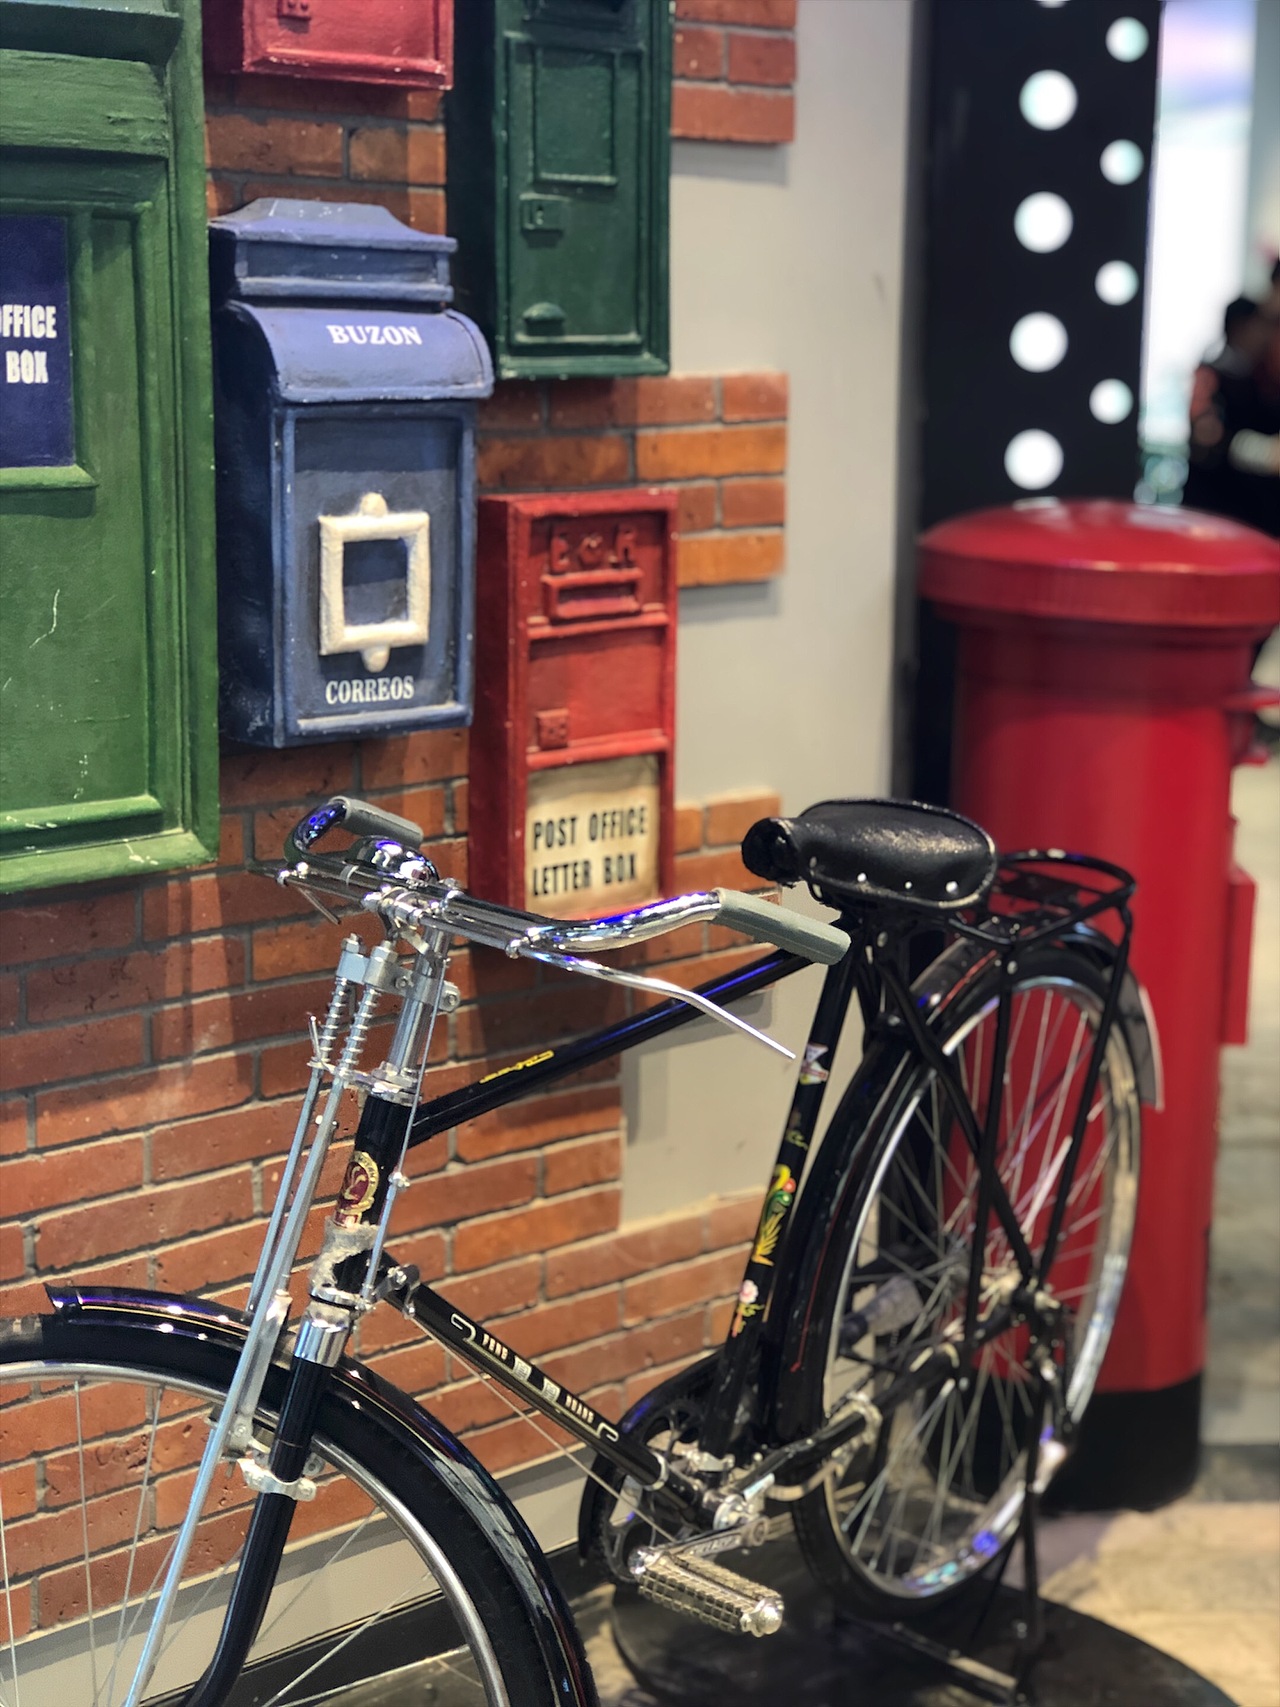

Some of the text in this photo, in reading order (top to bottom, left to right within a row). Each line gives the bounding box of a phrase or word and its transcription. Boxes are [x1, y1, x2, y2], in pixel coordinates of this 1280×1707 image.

[0, 304, 57, 339] FFICE
[326, 325, 422, 345] BUZON
[6, 349, 49, 384] BOX
[325, 675, 415, 704] CORREOS
[532, 806, 646, 851] POST OFFICE
[532, 853, 636, 897] LETTER BOX
